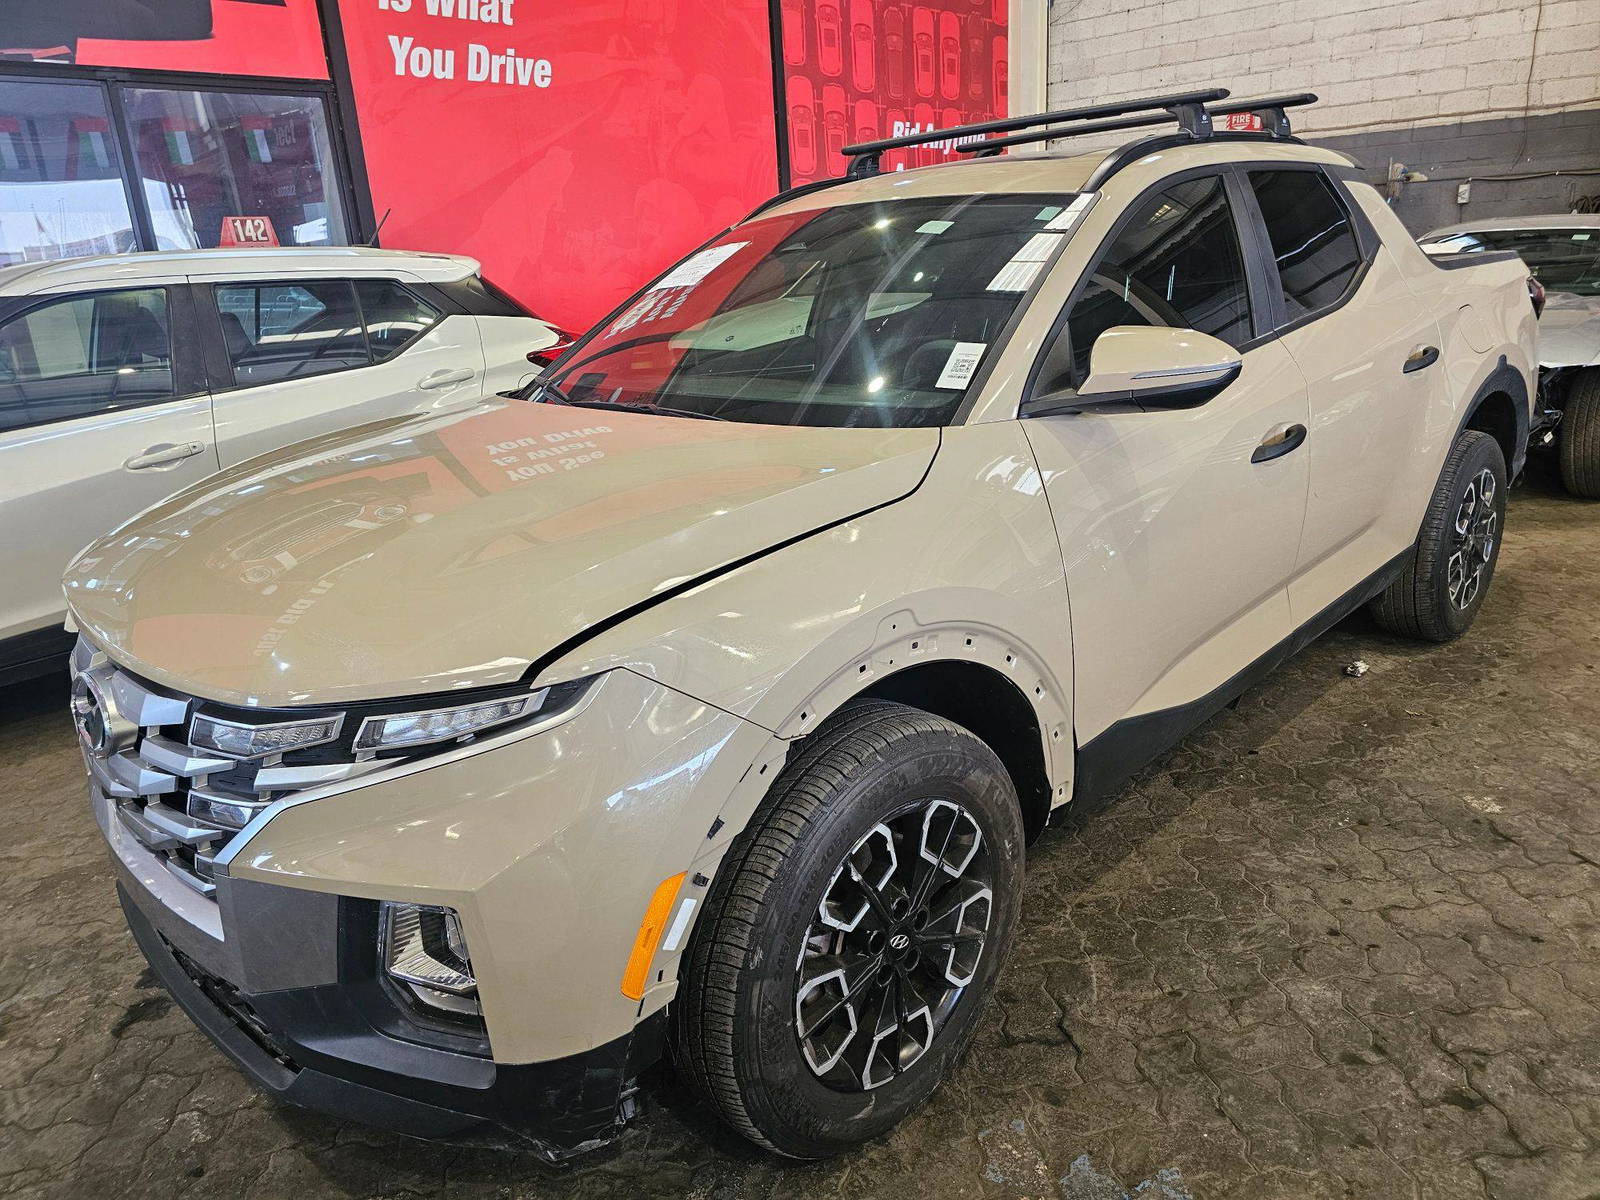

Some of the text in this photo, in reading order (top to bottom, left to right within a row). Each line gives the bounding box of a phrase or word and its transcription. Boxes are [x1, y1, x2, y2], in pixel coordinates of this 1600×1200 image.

[387, 35, 551, 88] You Drive
[1231, 114, 1251, 124] FIRE
[234, 219, 269, 242] 142
